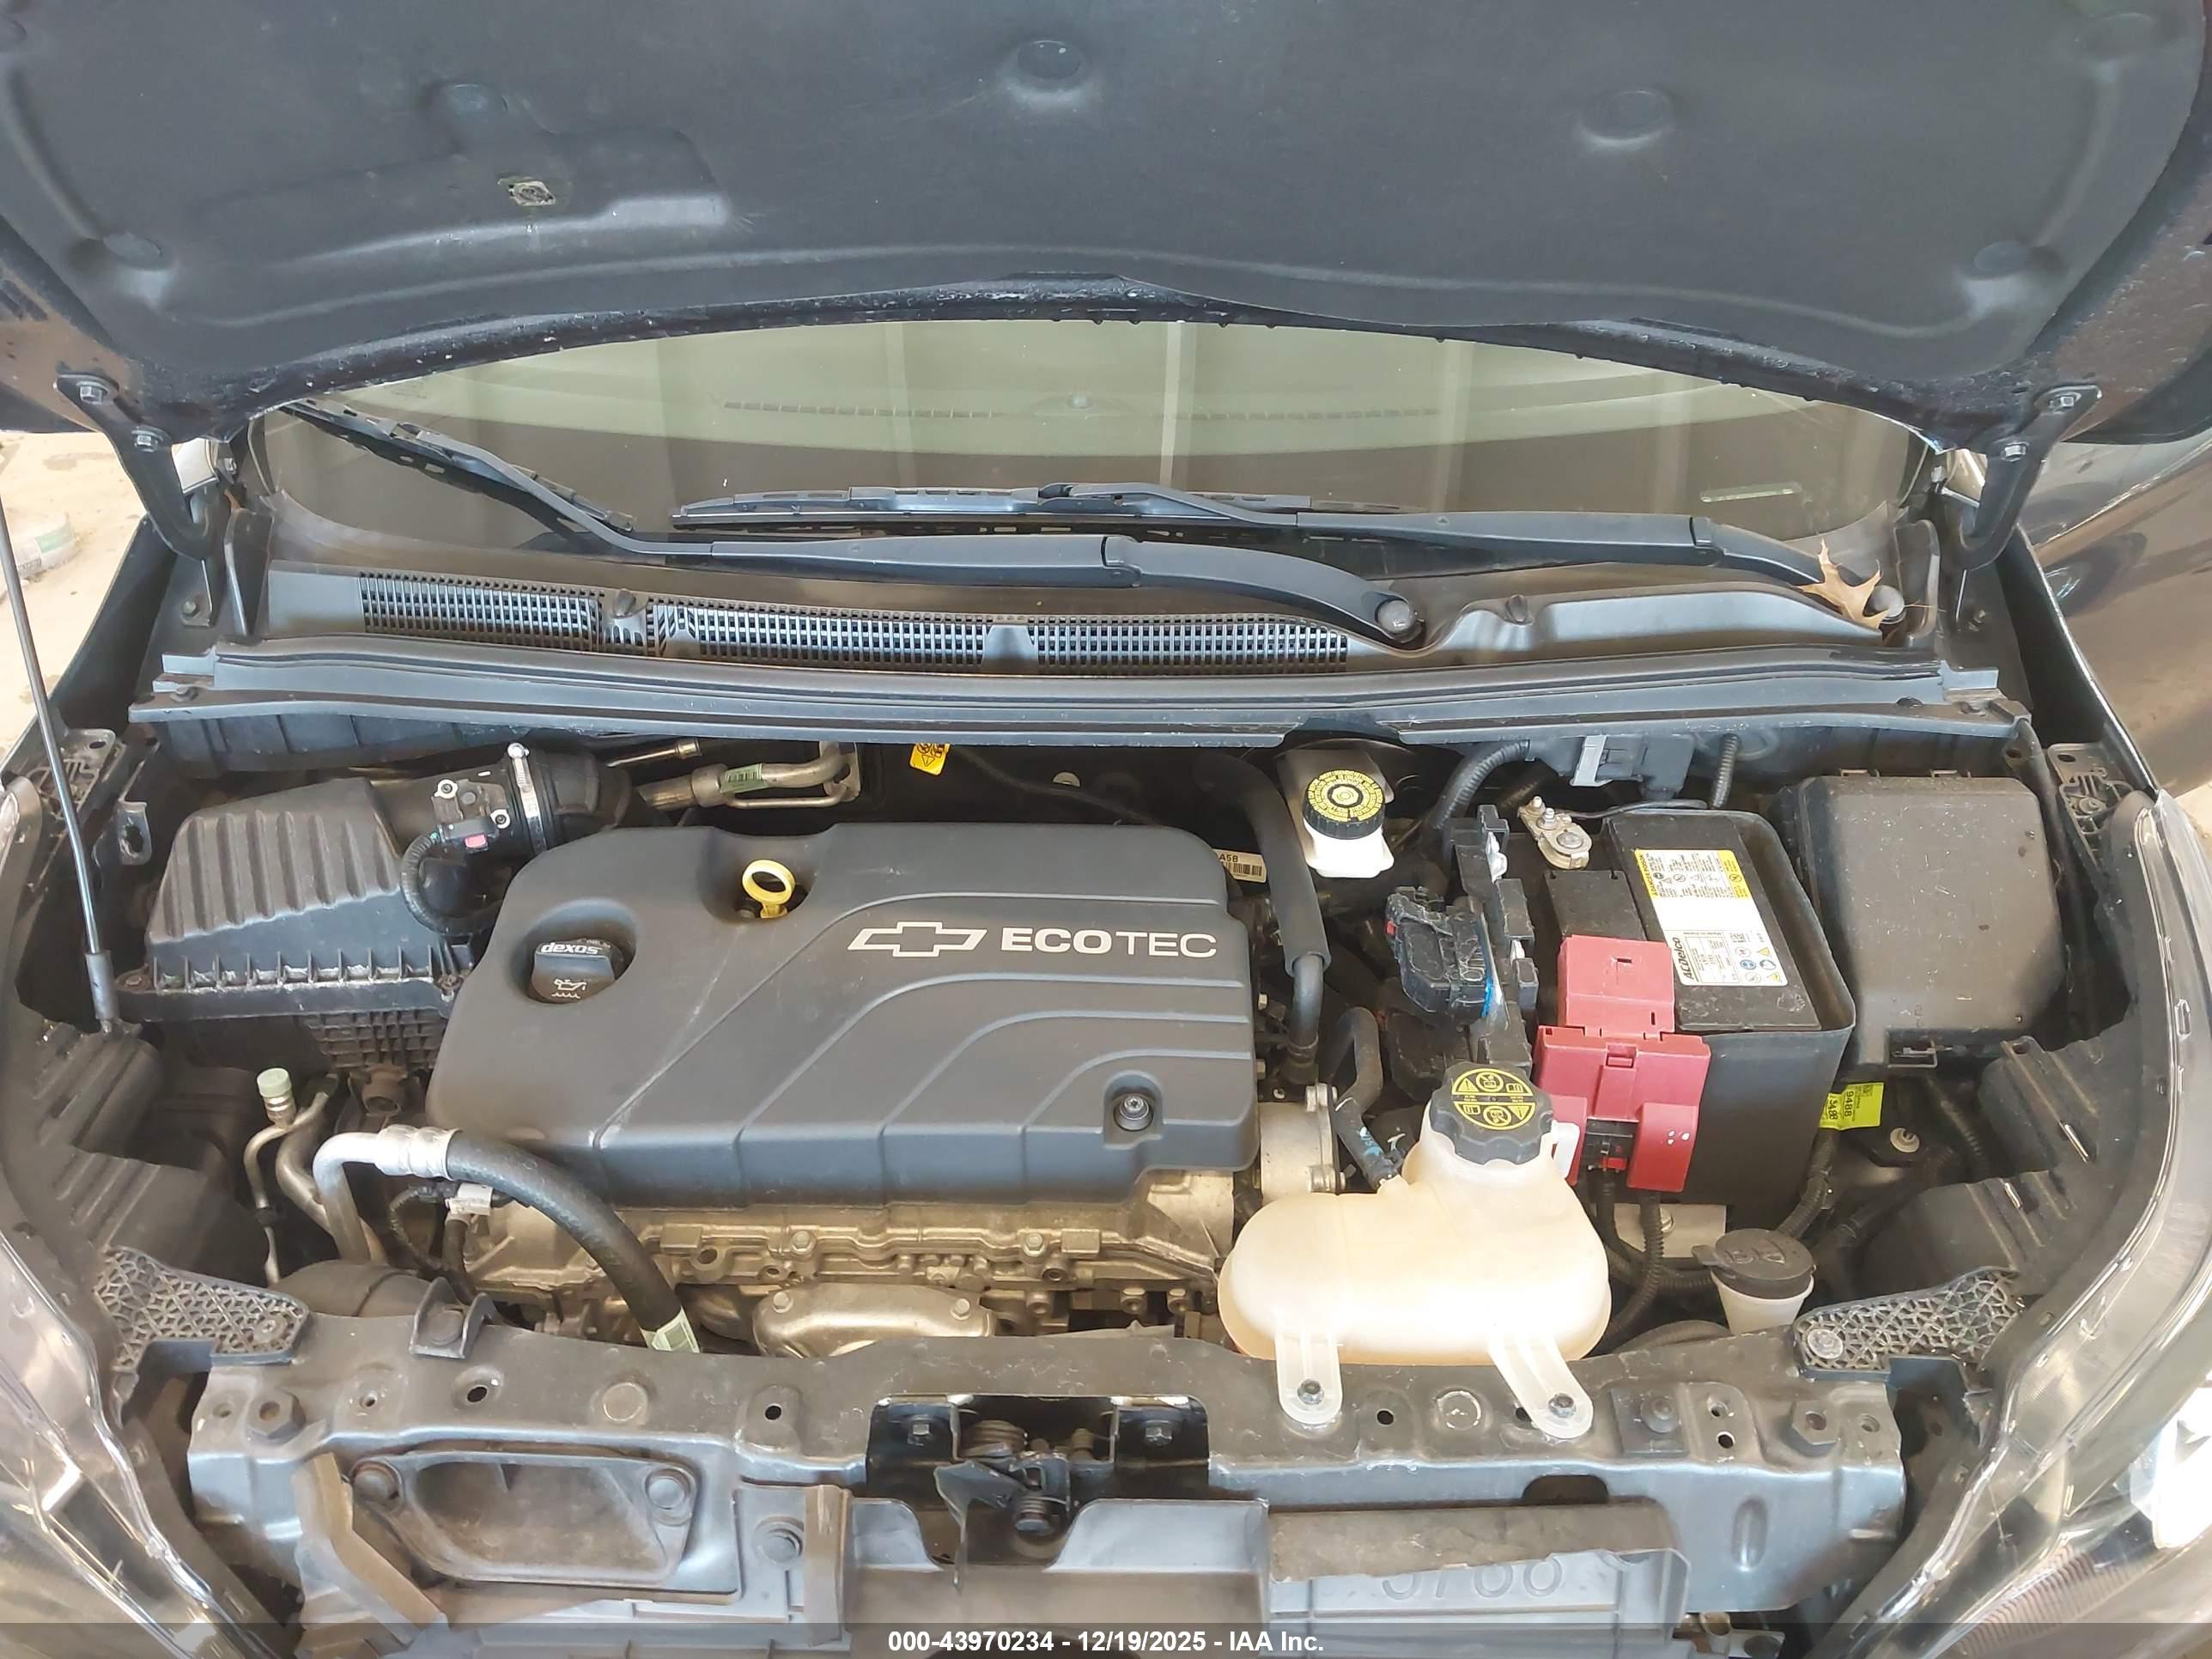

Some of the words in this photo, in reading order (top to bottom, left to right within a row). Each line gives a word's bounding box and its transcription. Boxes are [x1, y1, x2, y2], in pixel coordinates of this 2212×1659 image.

[540, 942, 603, 955] dexos
[1001, 927, 1217, 958] ECOTEC
[1672, 937, 1694, 980] ACDelco
